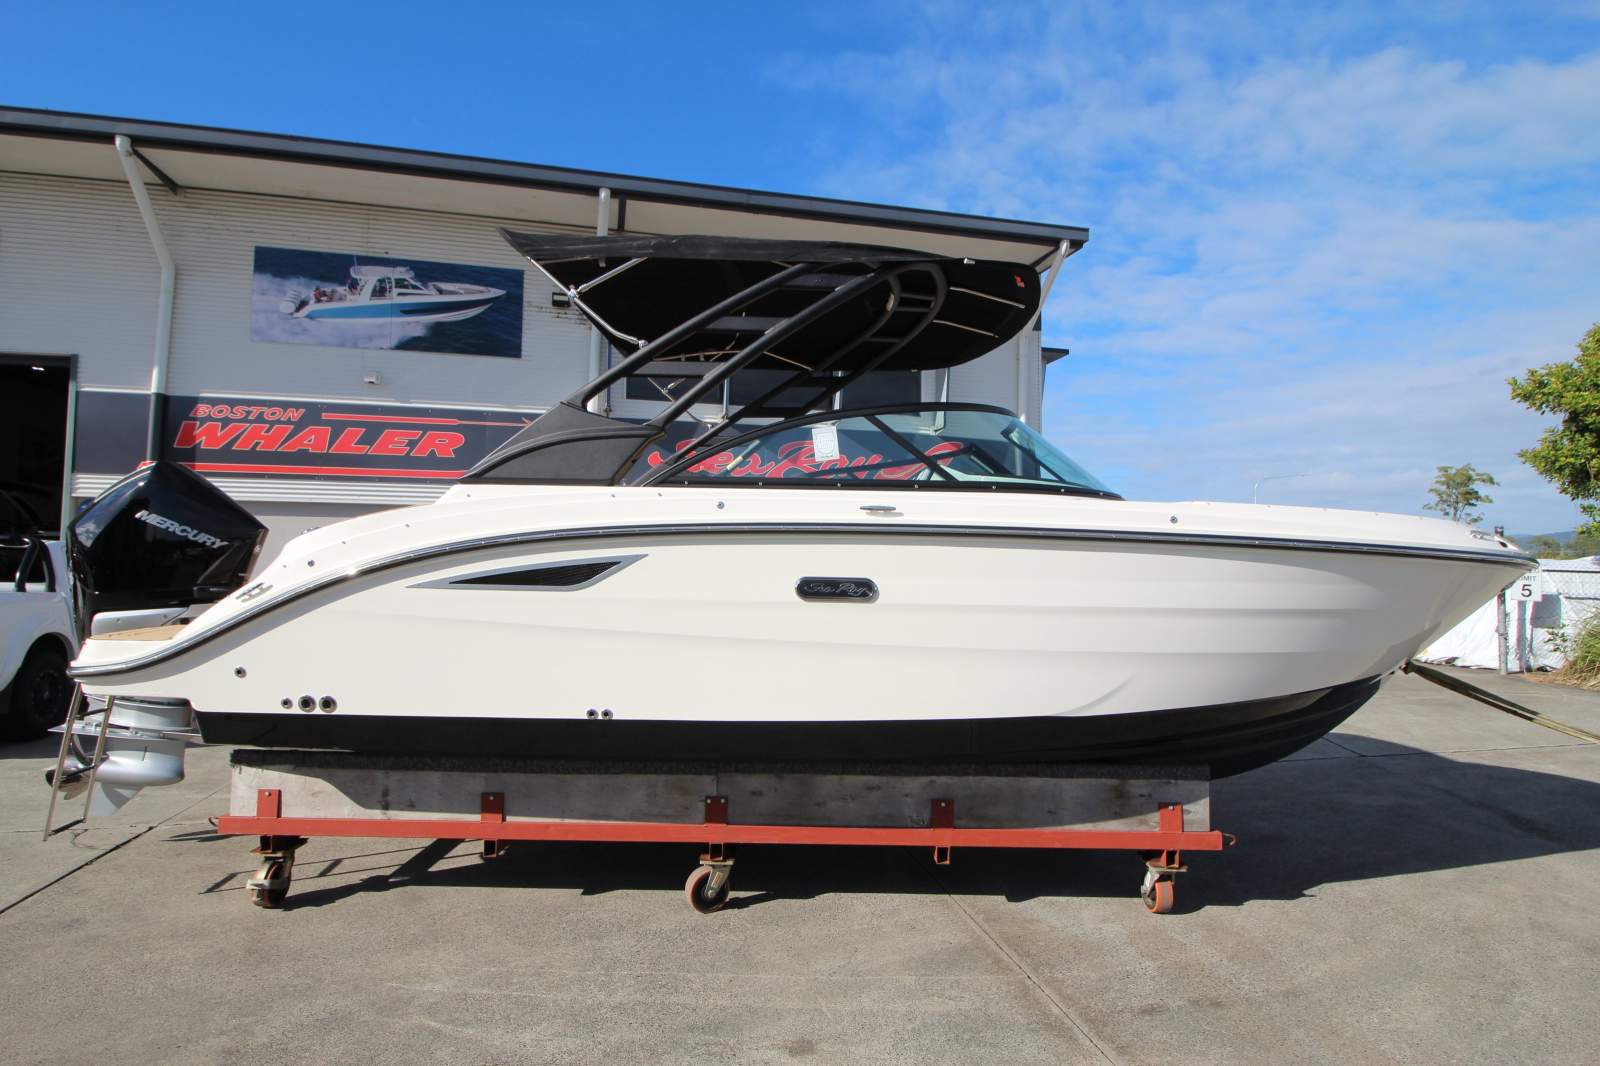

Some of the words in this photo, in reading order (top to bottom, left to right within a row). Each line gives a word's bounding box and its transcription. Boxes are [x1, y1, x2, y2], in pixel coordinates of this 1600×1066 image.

[189, 404, 305, 421] BOSTON
[173, 421, 465, 457] WHALER
[134, 509, 229, 549] MERCURY
[1520, 584, 1532, 598] 5
